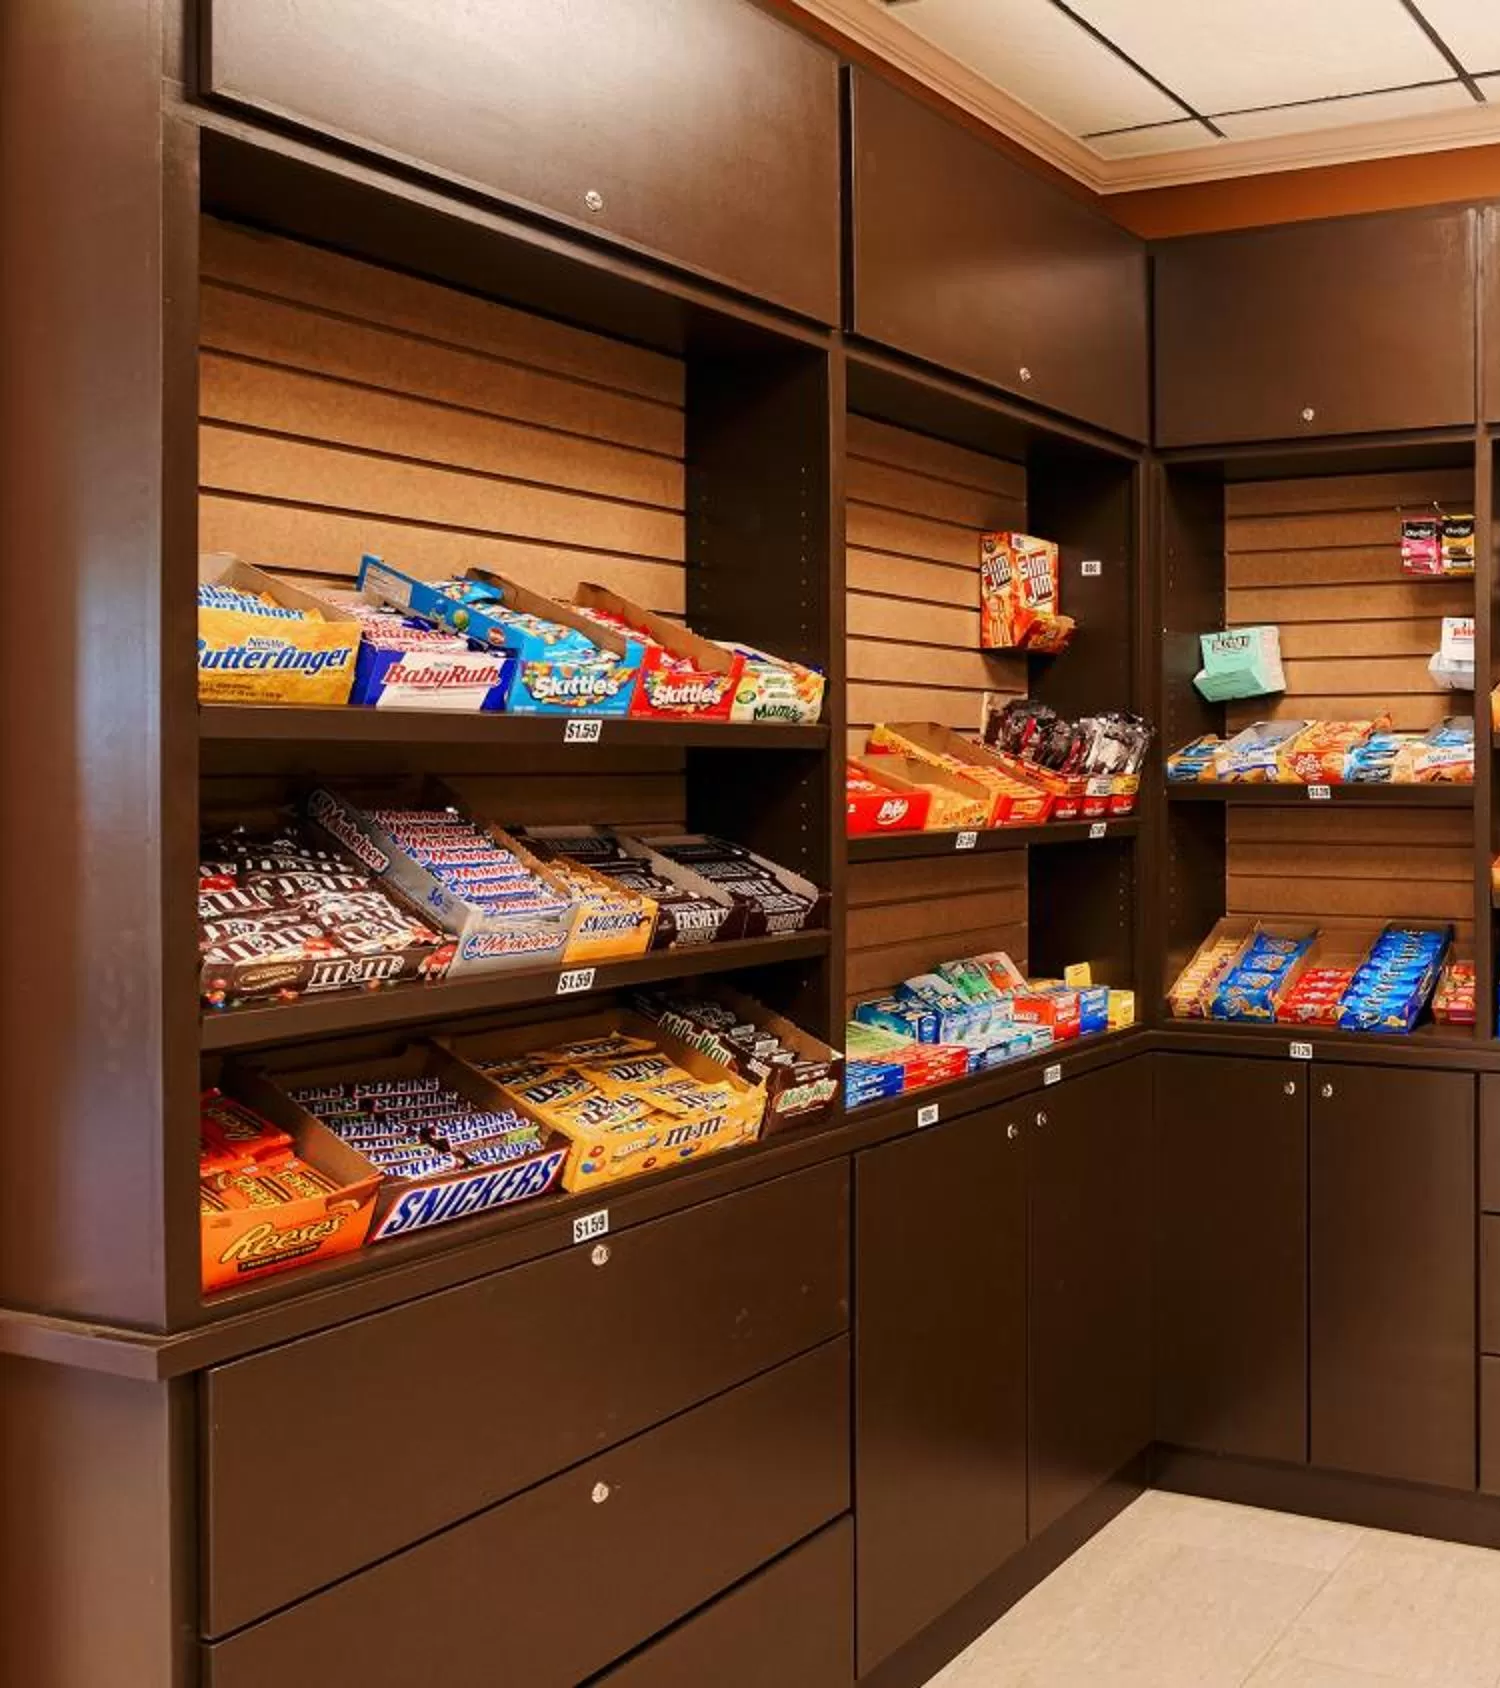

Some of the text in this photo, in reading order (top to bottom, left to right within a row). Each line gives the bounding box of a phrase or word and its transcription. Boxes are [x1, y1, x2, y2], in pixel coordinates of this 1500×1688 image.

[532, 675, 619, 698] Skittles
[652, 685, 722, 707] Skittles
[566, 723, 599, 740] $1.59
[559, 970, 593, 990] $1.59
[384, 1153, 556, 1235] SNICKERS
[574, 1212, 606, 1239] $1.59
